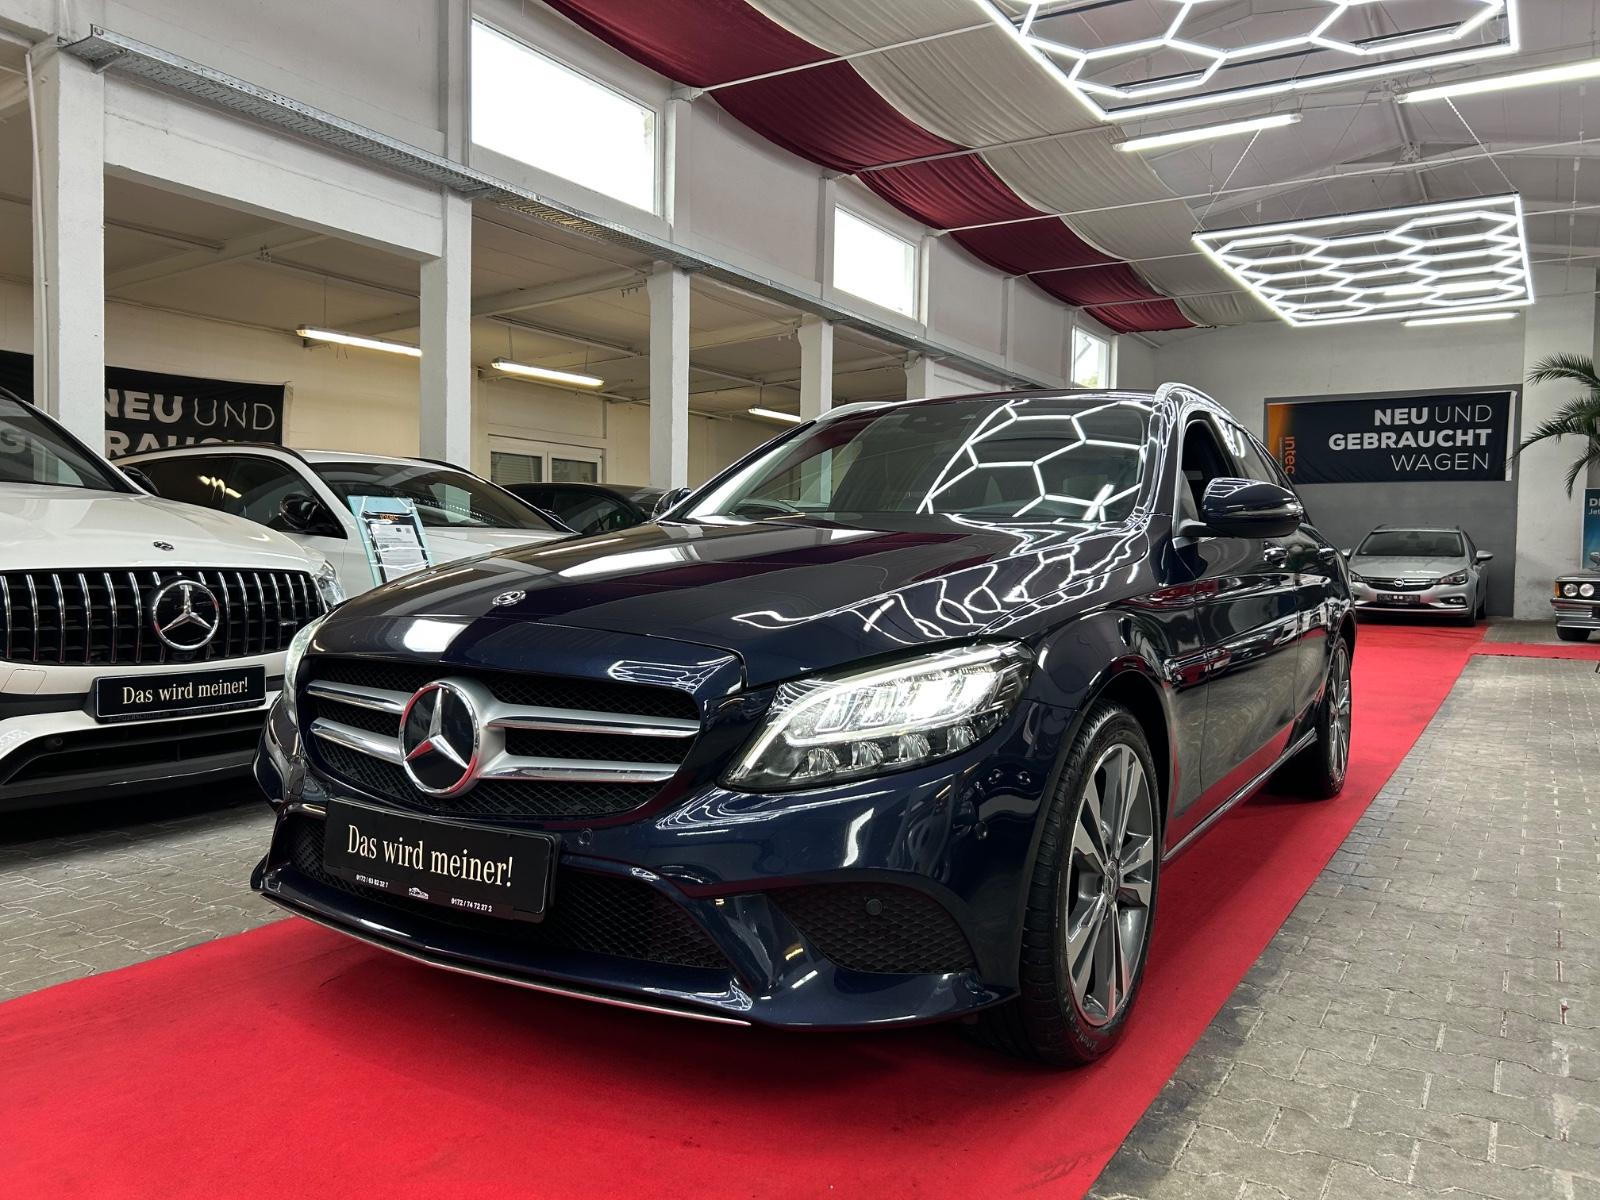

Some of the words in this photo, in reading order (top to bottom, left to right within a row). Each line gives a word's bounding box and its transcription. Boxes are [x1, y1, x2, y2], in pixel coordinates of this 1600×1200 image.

[194, 398, 275, 430] UND
[1374, 407, 1428, 426] NEU
[1435, 405, 1492, 424] UND
[1328, 429, 1492, 451] GEBRAUCHT
[1391, 453, 1489, 471] WAGEN
[122, 686, 153, 705] Das
[159, 681, 193, 701] wird
[198, 676, 248, 698] meiner!
[347, 824, 377, 860] Das
[383, 836, 424, 870] wird
[430, 848, 513, 887] meiner!
